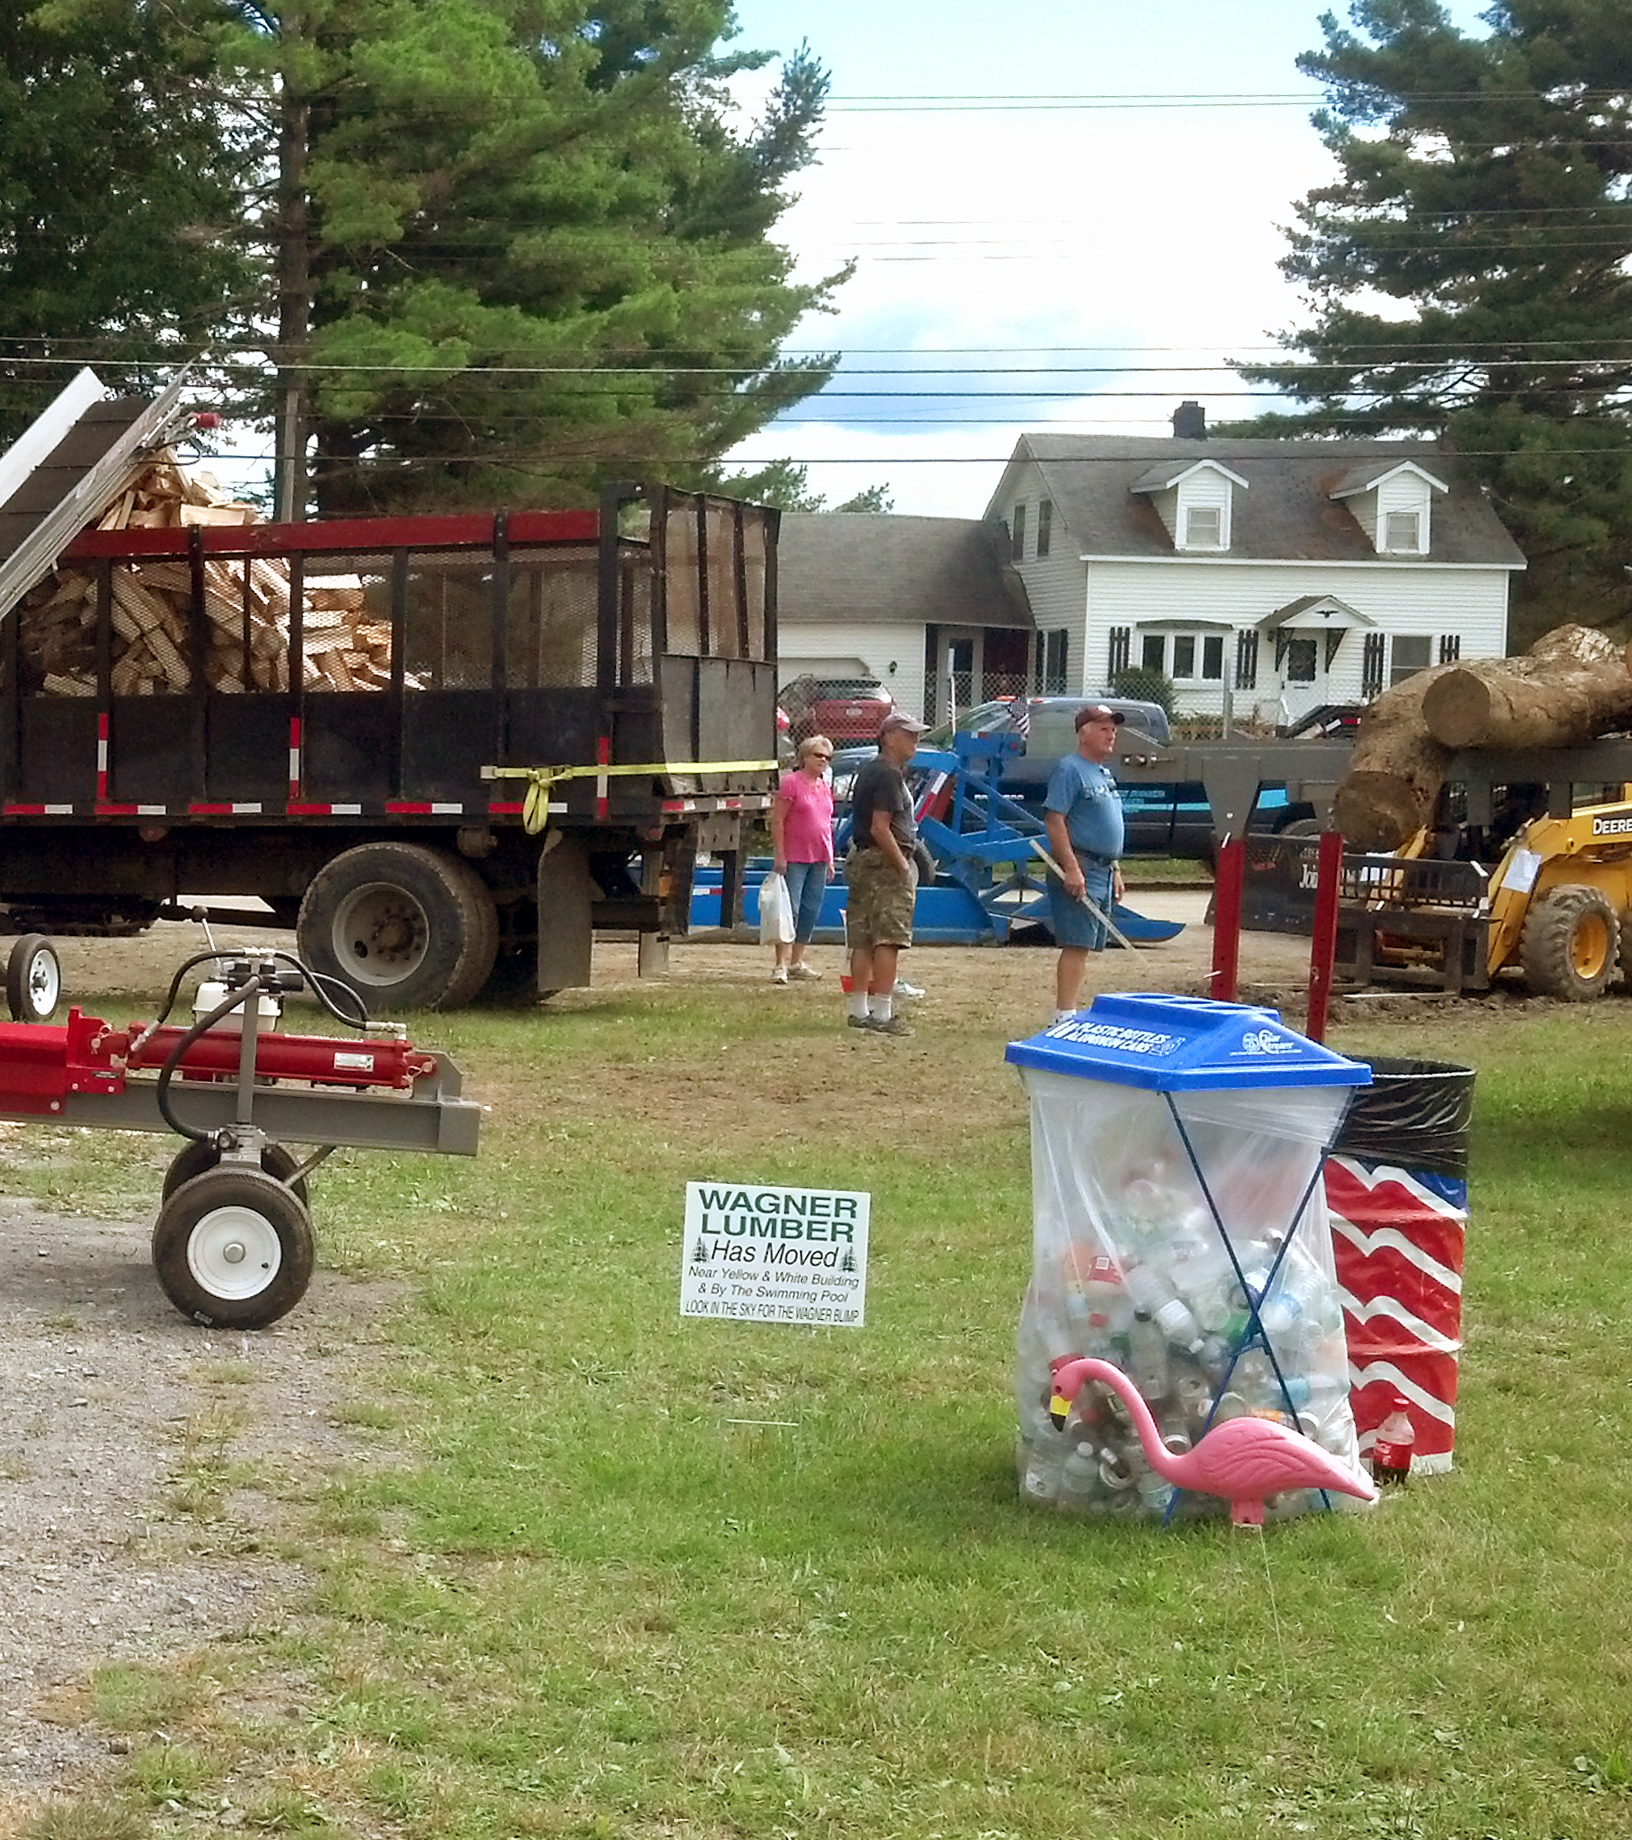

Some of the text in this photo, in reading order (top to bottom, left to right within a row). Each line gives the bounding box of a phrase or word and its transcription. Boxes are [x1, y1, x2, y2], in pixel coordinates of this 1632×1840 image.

[1593, 818, 1632, 834] DEERE
[1076, 1022, 1171, 1044] PLASTIC BOTTLES
[699, 1189, 858, 1218] WAGNER
[701, 1214, 854, 1243] LUMBER
[711, 1239, 839, 1267] Has Moved
[688, 1266, 859, 1290] Near Yellow & White Building
[698, 1283, 848, 1303] & By The Swimming Pool
[686, 1299, 709, 1314] LOOK
[711, 1301, 720, 1314] IN
[722, 1302, 738, 1315] THE
[739, 1303, 756, 1316] SKY
[758, 1304, 775, 1317] FOR
[778, 1305, 794, 1319] THE
[796, 1306, 831, 1321] WAGNER
